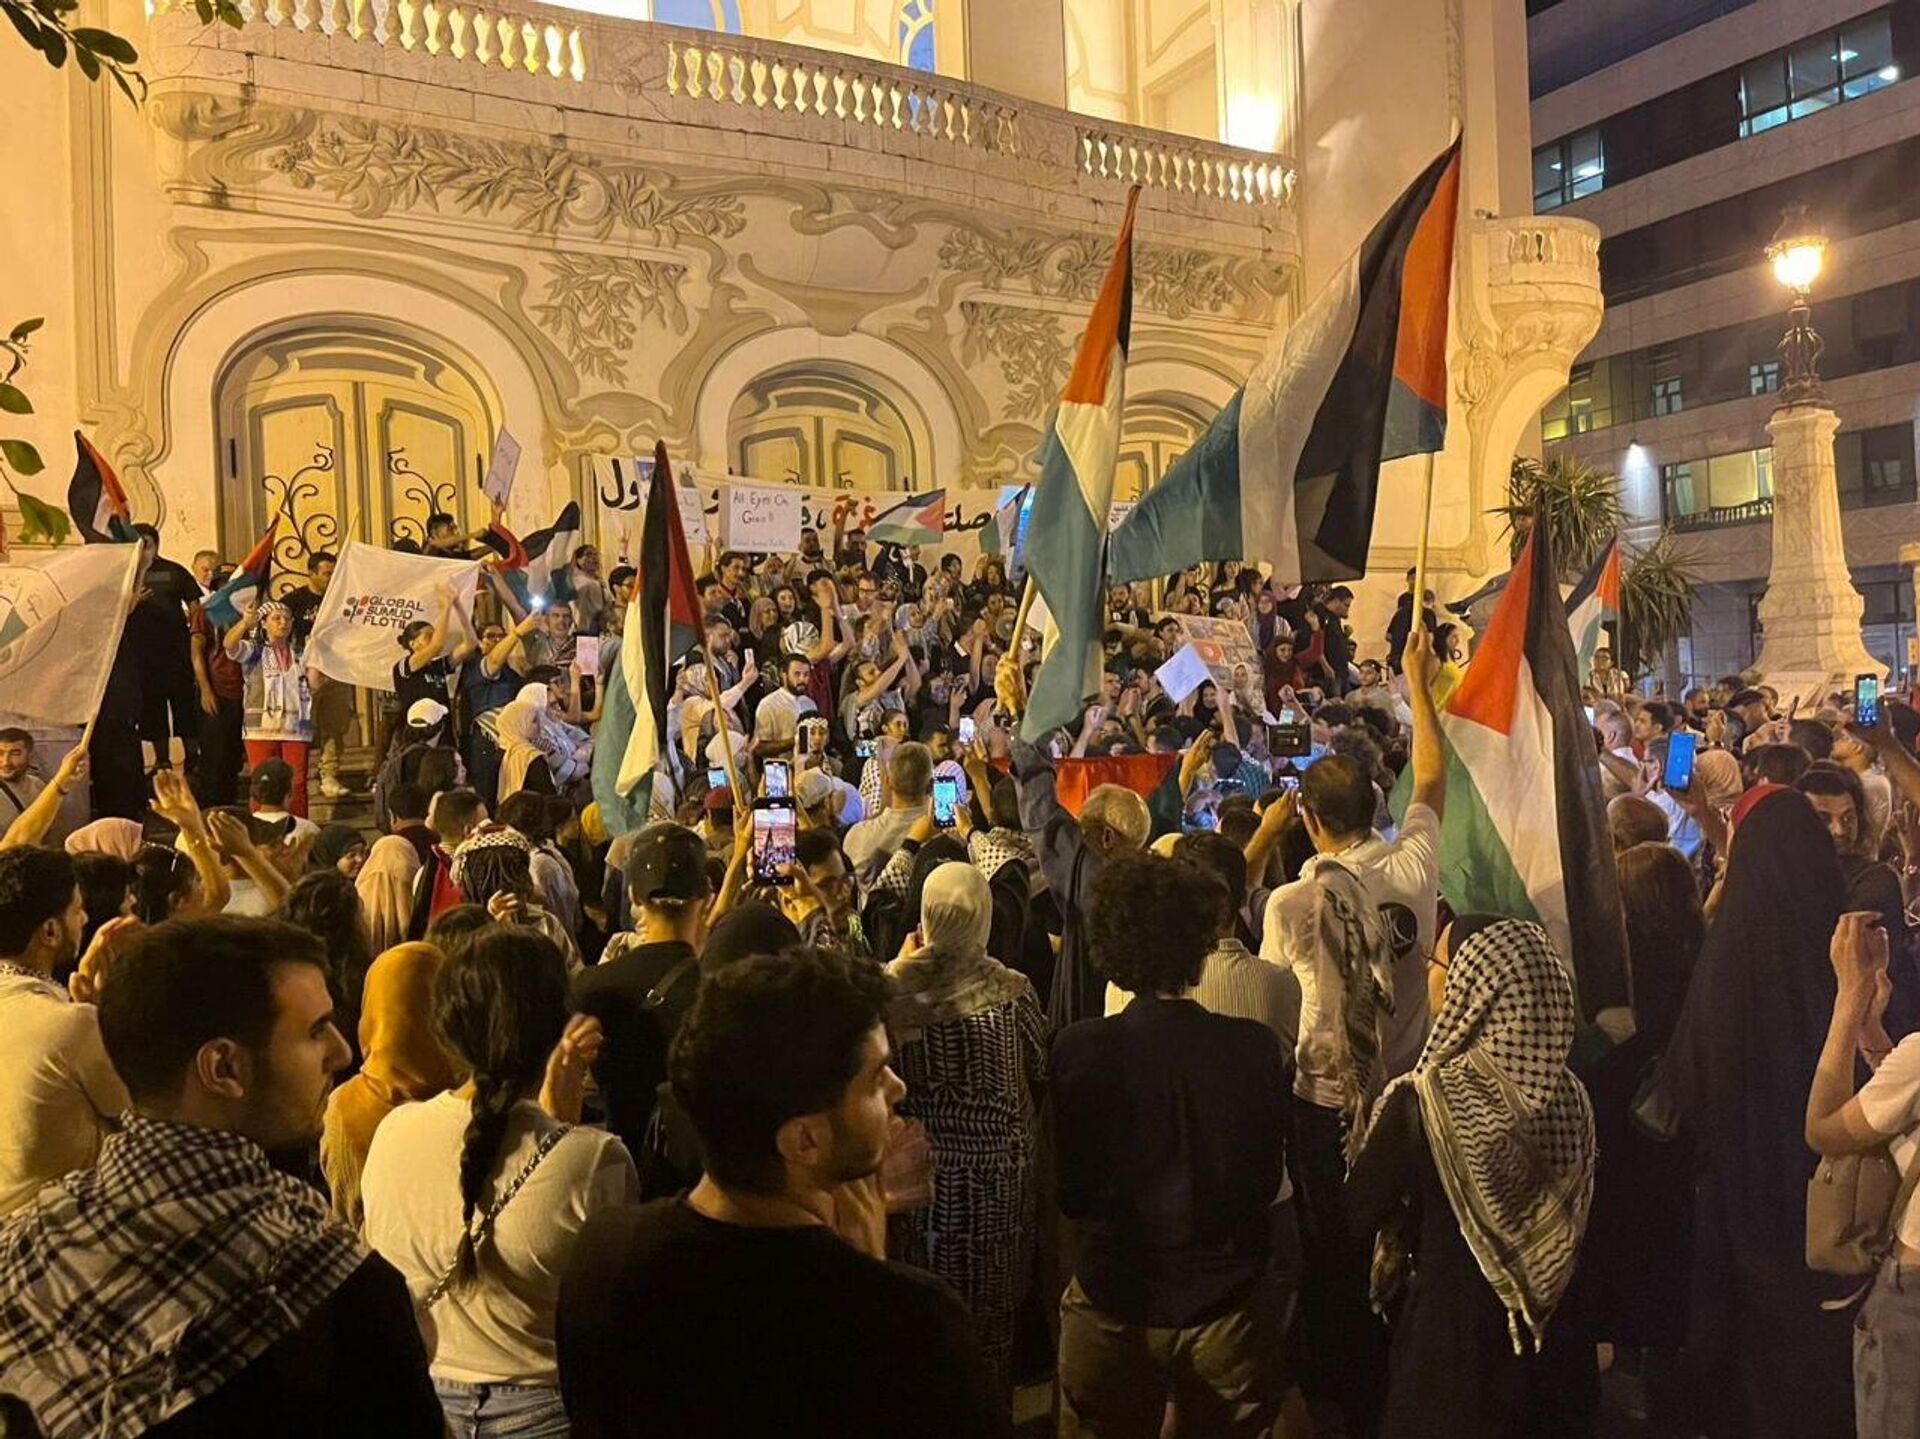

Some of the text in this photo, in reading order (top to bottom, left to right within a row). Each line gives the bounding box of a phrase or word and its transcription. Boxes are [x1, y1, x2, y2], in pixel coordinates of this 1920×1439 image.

[369, 596, 424, 612] GLOBAL
[366, 605, 413, 620] SUMUD
[363, 615, 407, 629] FLOTIL
